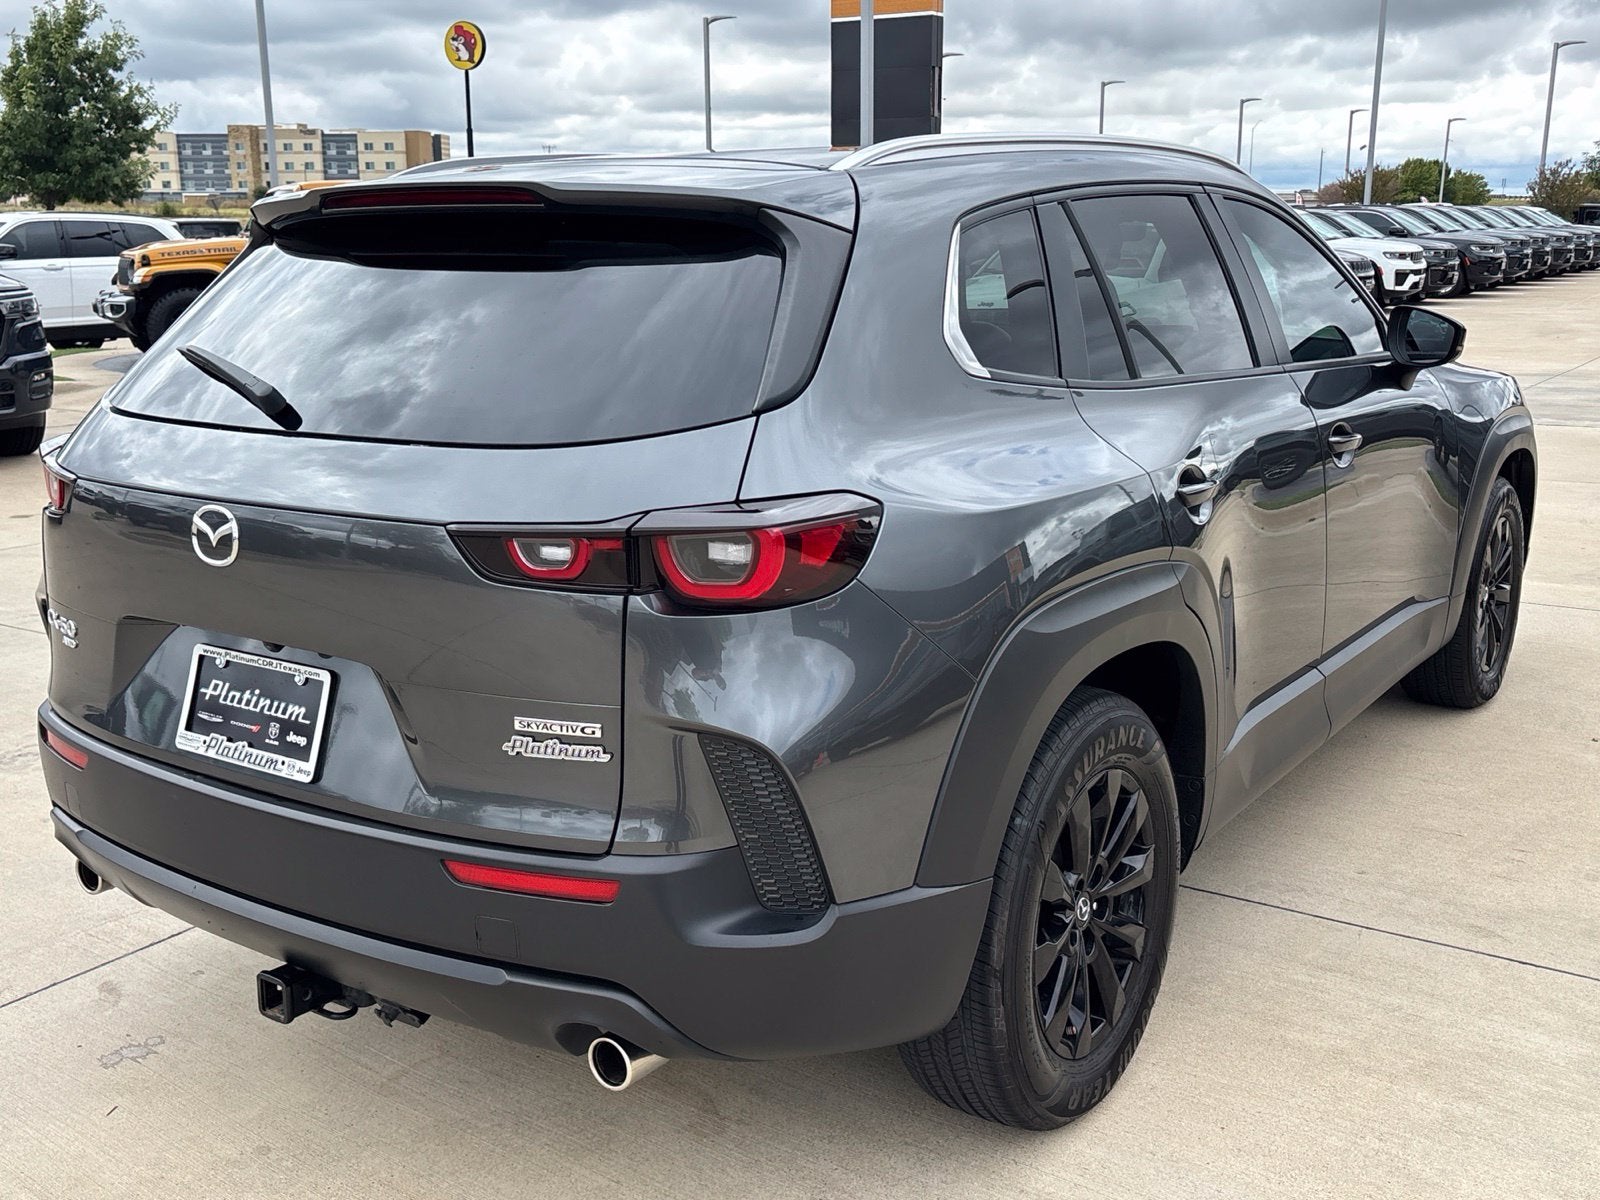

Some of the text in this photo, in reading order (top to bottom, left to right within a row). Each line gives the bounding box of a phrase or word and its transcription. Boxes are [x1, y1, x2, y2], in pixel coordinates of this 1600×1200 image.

[159, 249, 197, 257] TEXAS
[202, 648, 321, 679] www.PlatinumCDRJTexas.com
[200, 679, 310, 724] Platinum
[286, 731, 307, 747] Jeep
[502, 736, 613, 762] Platinum
[204, 737, 312, 778] Platinum Jeep
